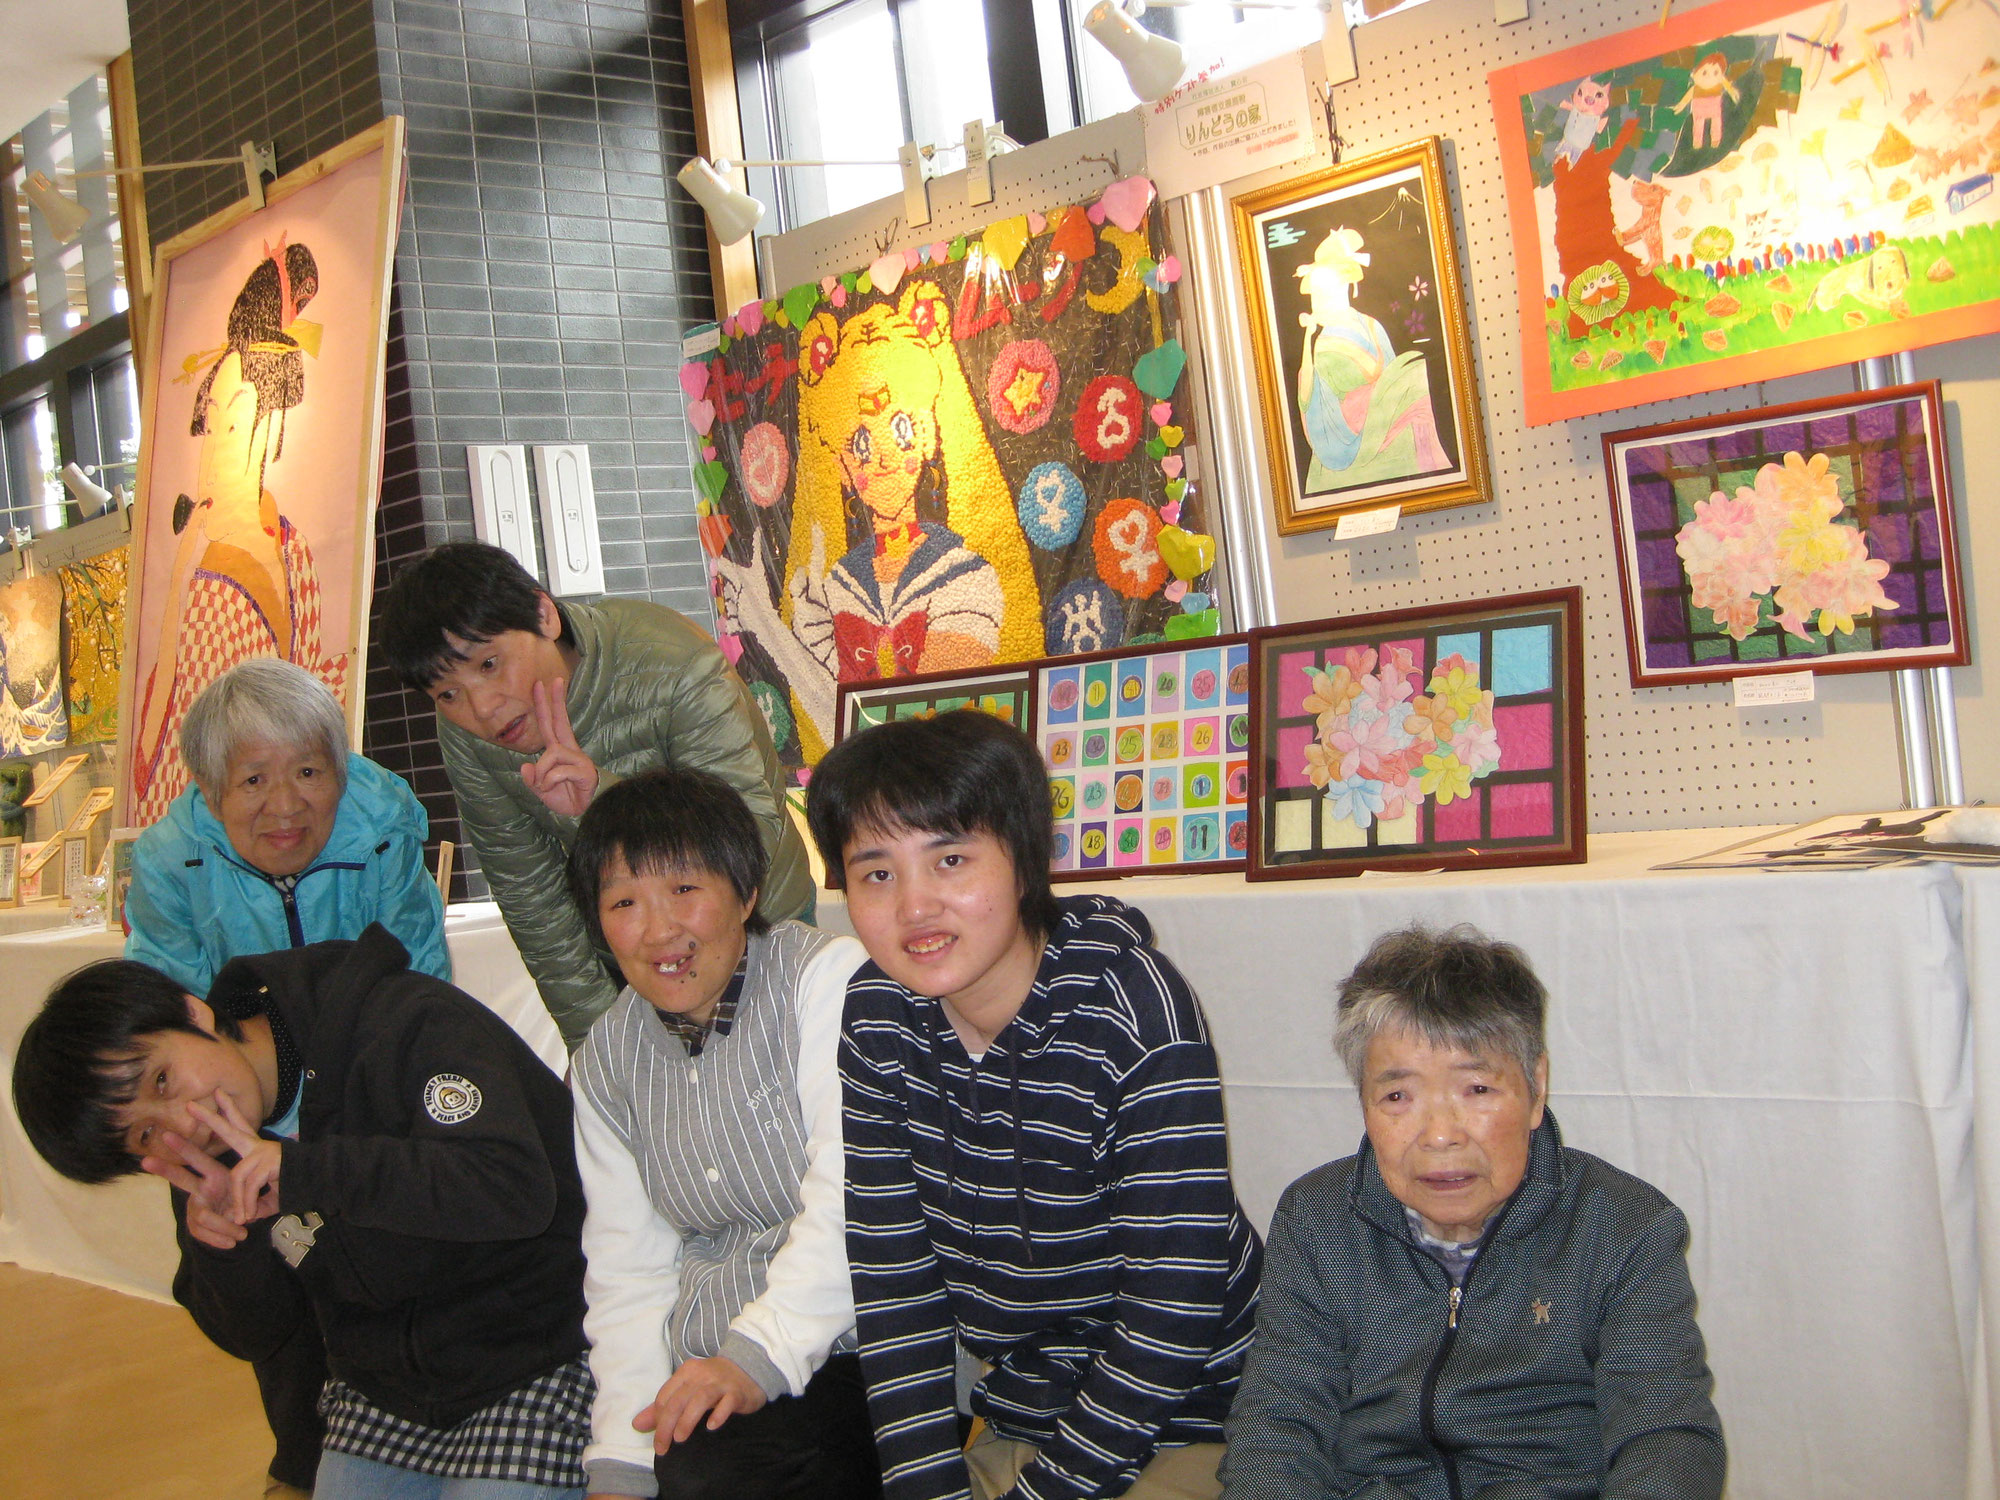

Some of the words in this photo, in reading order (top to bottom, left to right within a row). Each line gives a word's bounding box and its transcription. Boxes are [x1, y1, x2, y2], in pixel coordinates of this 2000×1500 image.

[1185, 103, 1262, 146] りんどうの家
[1121, 734, 1138, 755] 25
[1195, 729, 1211, 745] 26
[1189, 823, 1209, 851] 11
[425, 1079, 437, 1106] FUNKY
[437, 1074, 464, 1083] FRESH
